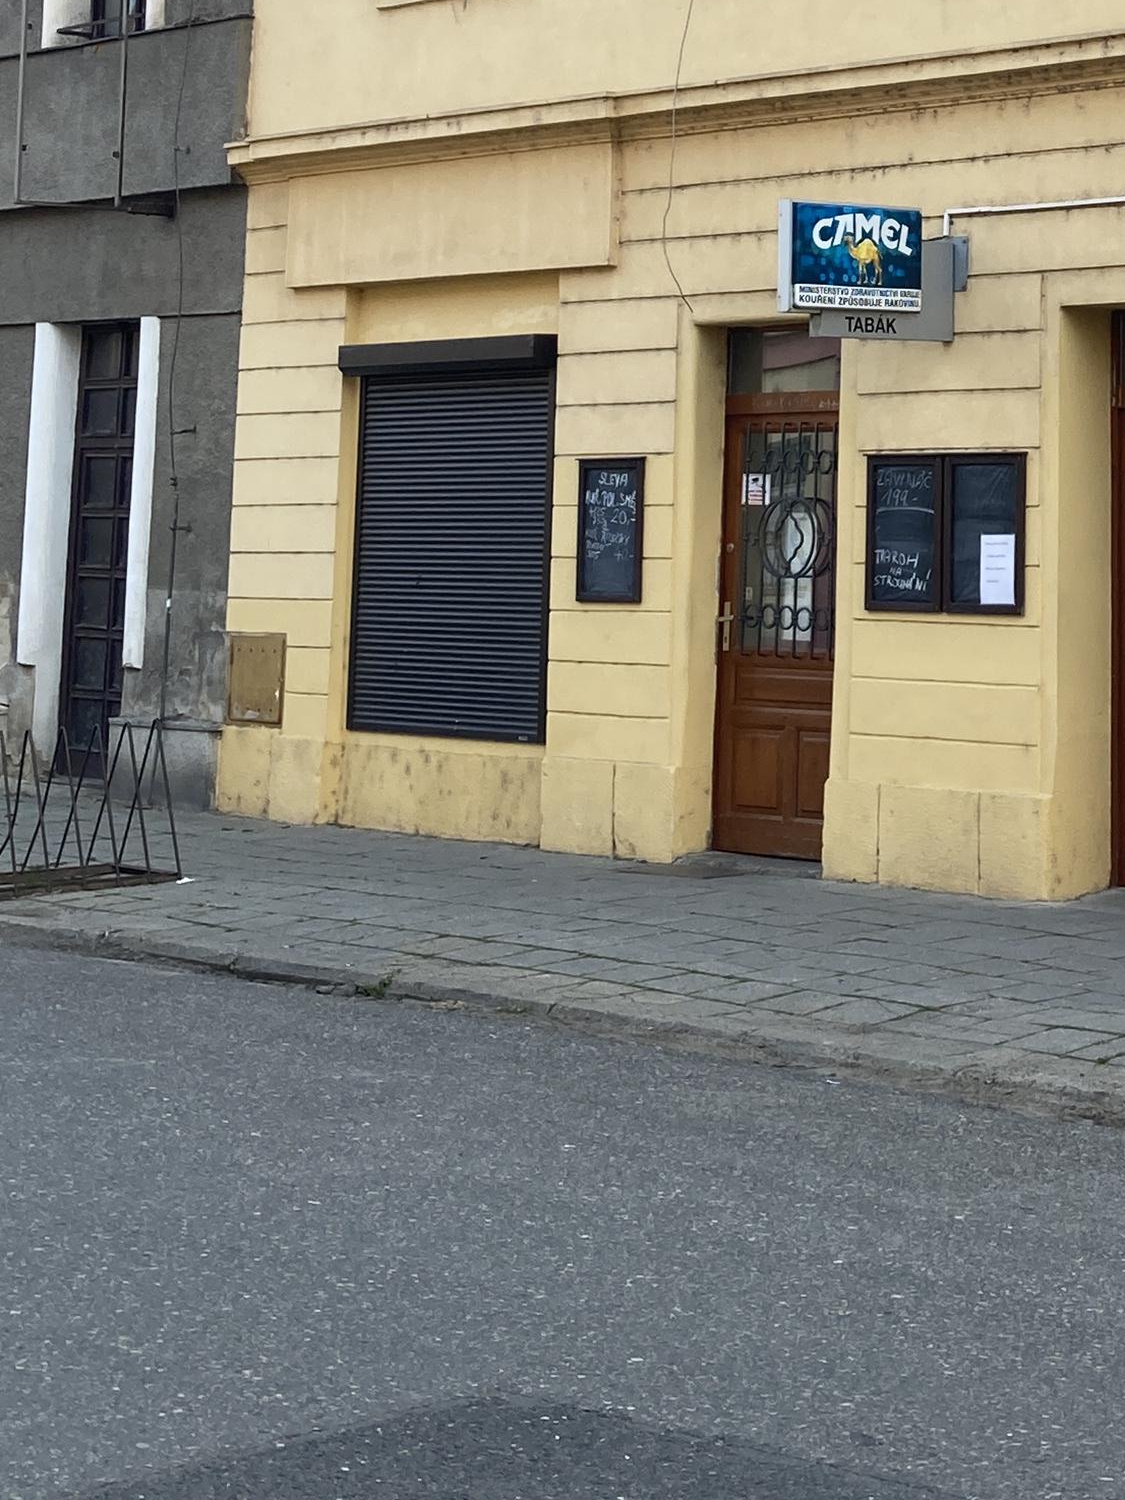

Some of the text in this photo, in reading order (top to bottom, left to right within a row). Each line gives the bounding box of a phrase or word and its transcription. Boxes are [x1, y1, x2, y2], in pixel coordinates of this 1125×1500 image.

[812, 212, 913, 257] CAMEL
[799, 294, 836, 305] KOUŘENÍ
[838, 295, 882, 307] ZPŮSOBUJE
[845, 313, 897, 334] TABÁK
